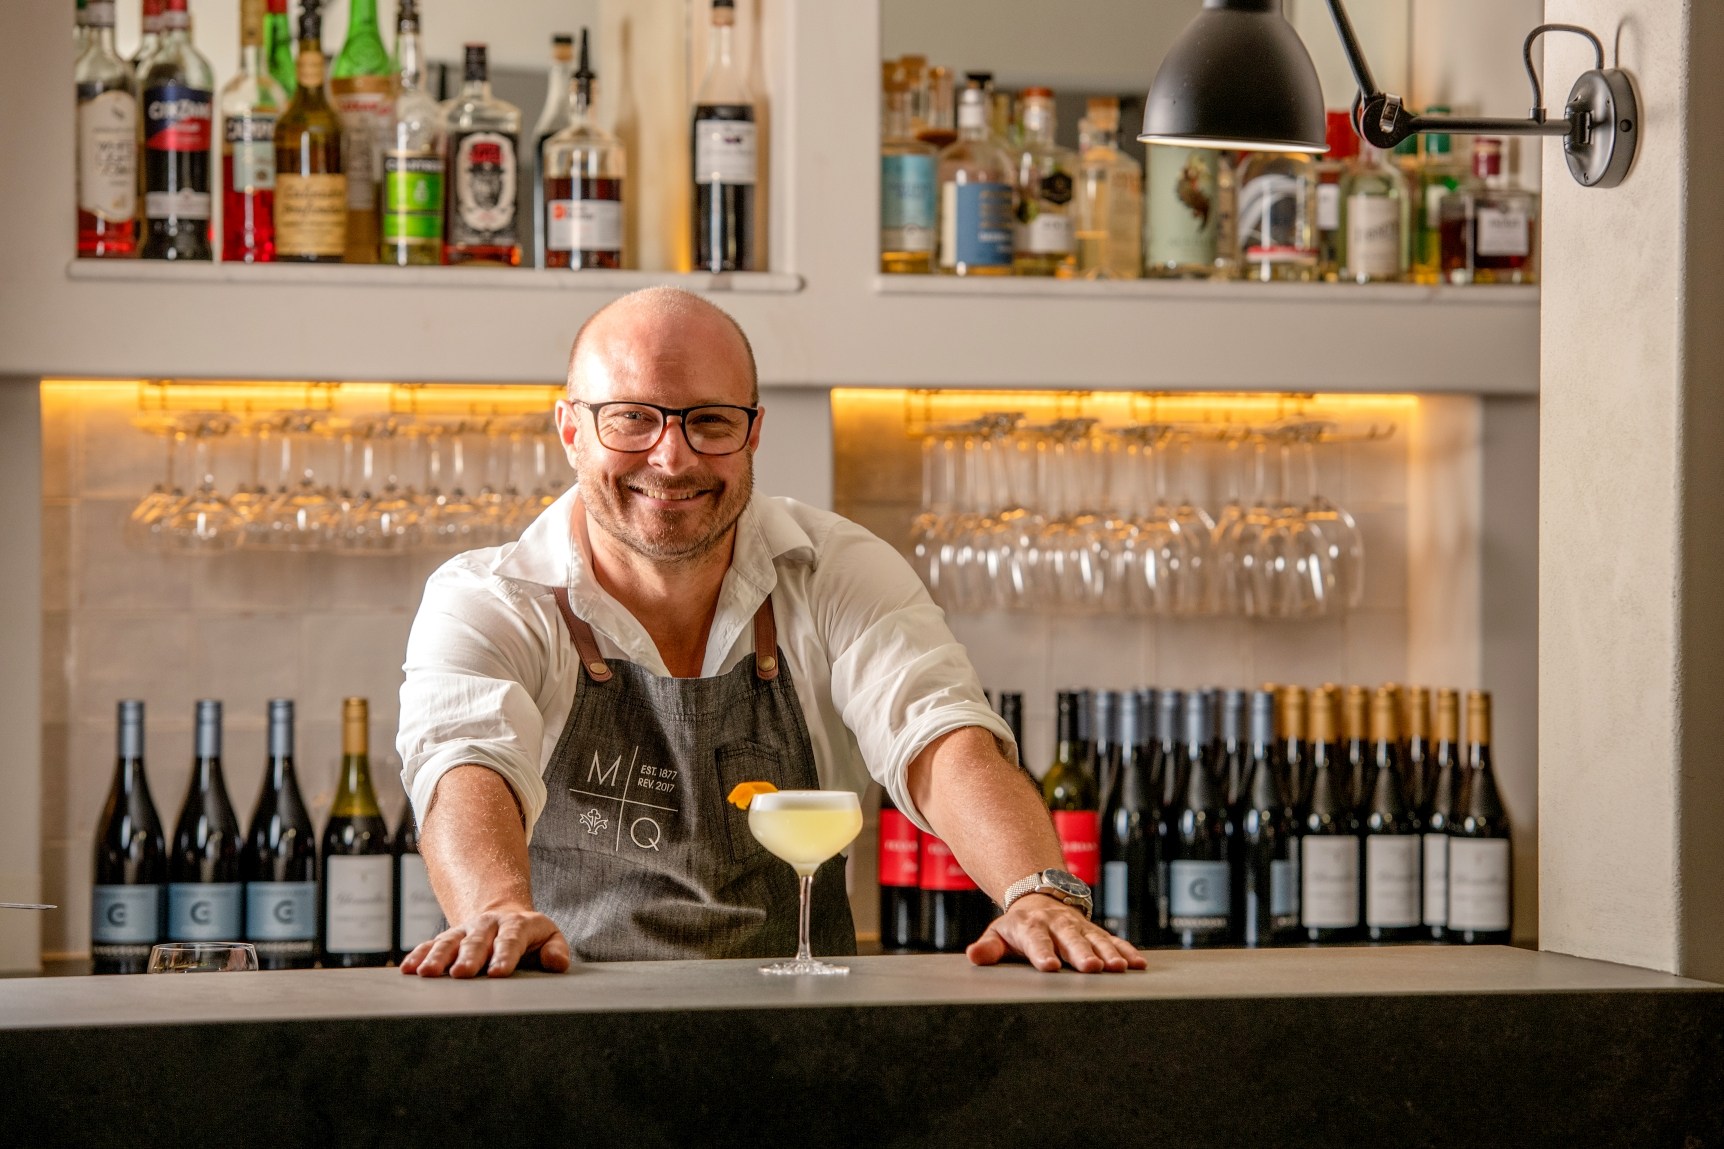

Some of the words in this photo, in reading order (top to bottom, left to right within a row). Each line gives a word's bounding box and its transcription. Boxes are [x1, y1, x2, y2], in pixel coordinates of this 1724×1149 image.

[587, 749, 621, 787] M
[640, 764, 657, 776] EST.
[658, 768, 678, 781] 1877
[637, 777, 654, 789] REV.
[655, 781, 675, 793] 2017
[630, 816, 661, 852] Q
